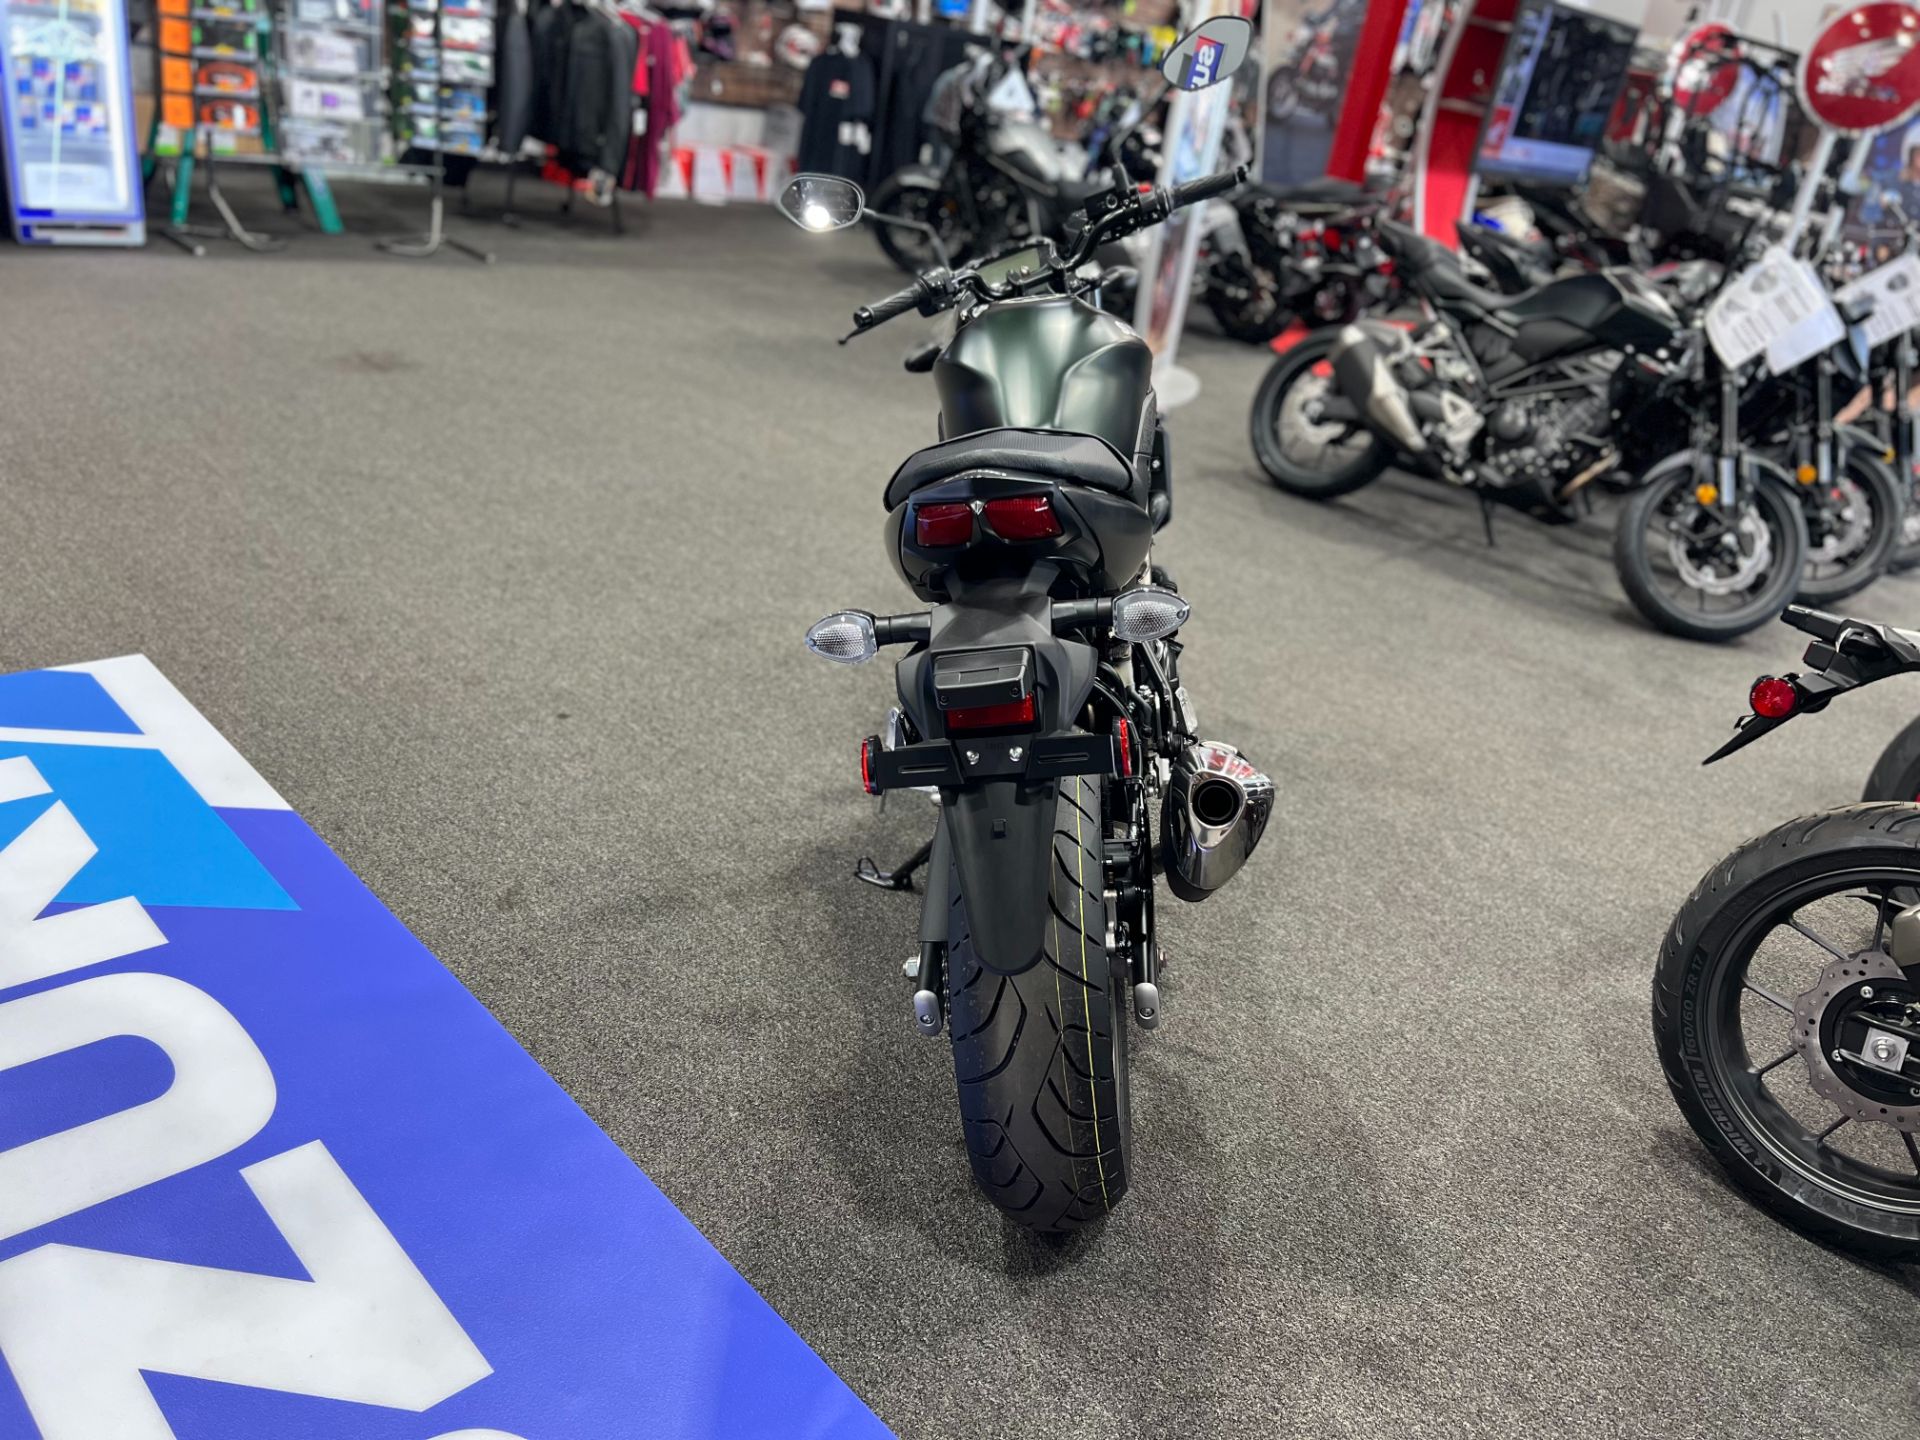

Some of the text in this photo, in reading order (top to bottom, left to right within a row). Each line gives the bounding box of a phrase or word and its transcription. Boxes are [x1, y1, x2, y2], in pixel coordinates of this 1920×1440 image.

[1683, 953, 1754, 1155] MICHELIN 160/60 ZR 17
